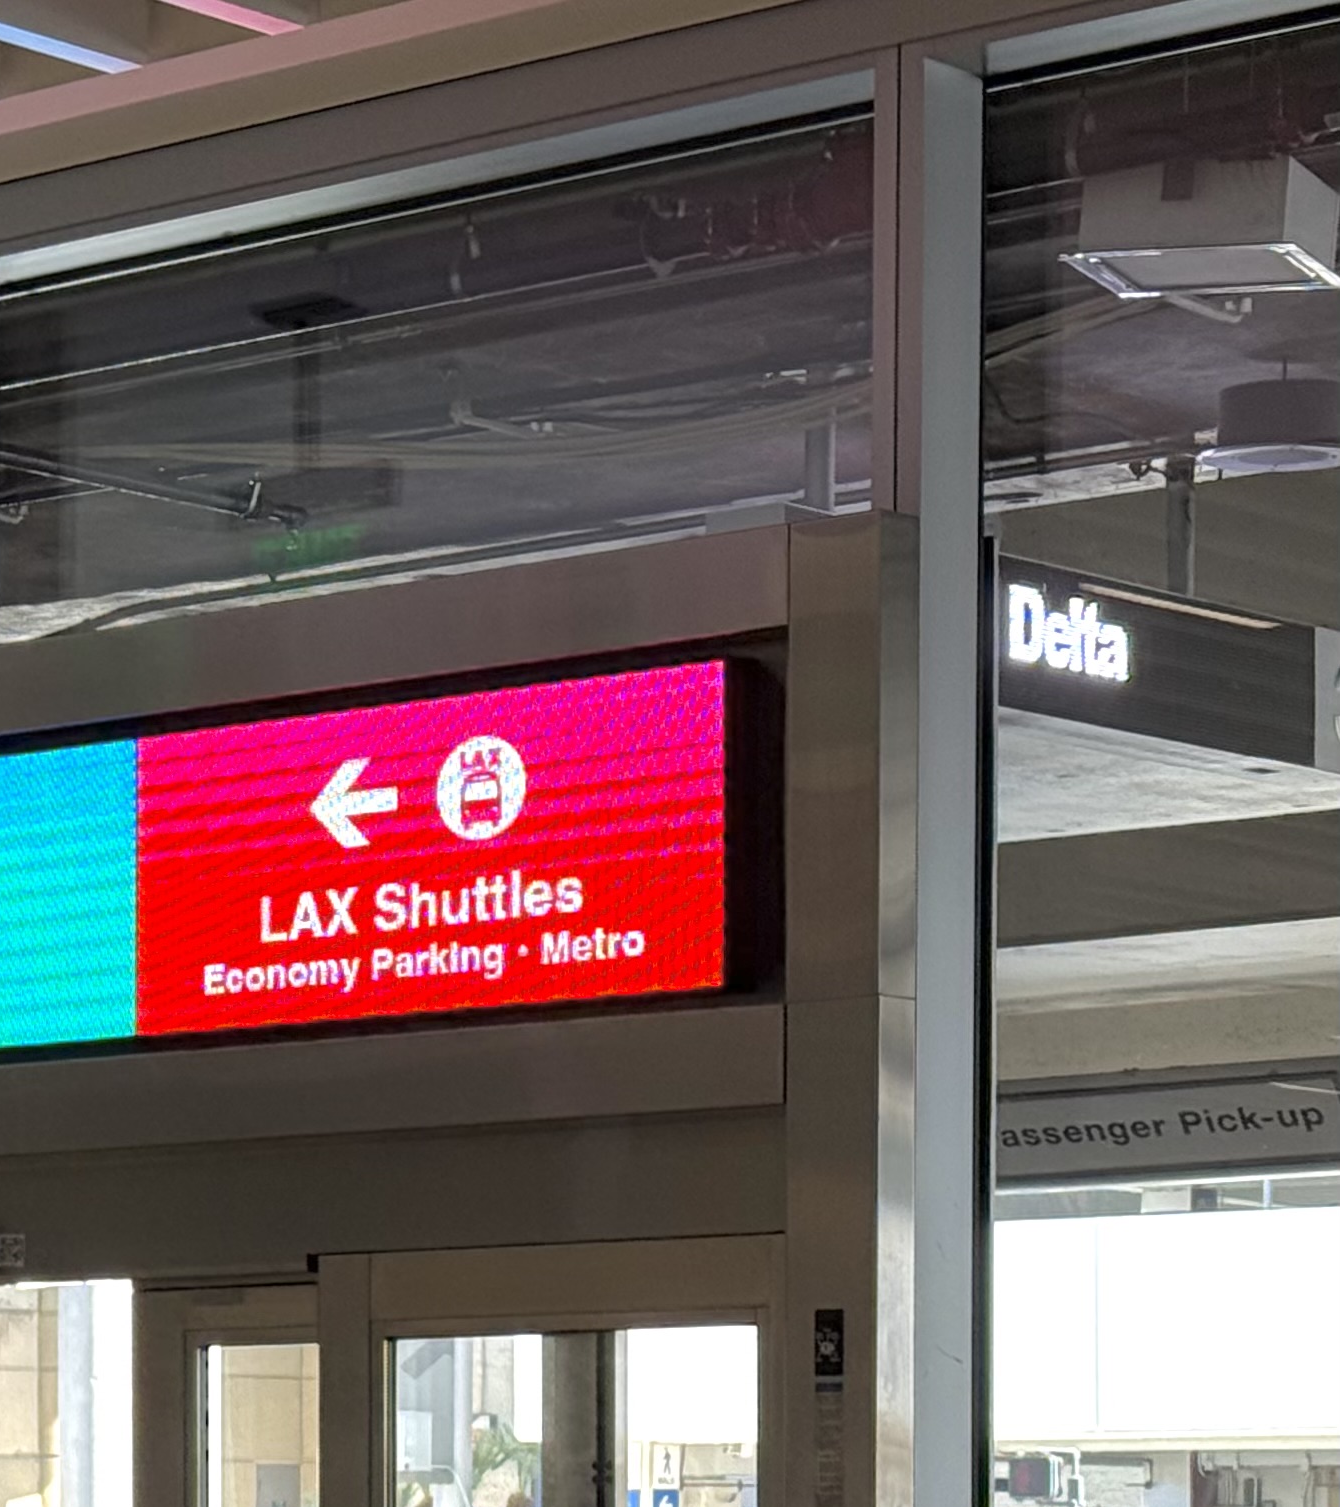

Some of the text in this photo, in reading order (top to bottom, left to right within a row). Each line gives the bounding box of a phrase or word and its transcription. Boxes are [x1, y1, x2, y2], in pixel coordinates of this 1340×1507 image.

[1008, 584, 1130, 681] Delta
[259, 869, 584, 944] LAX Shuttles
[203, 926, 646, 996] Economy Parking Metro
[1001, 1106, 1325, 1147] assenger Pick-up
